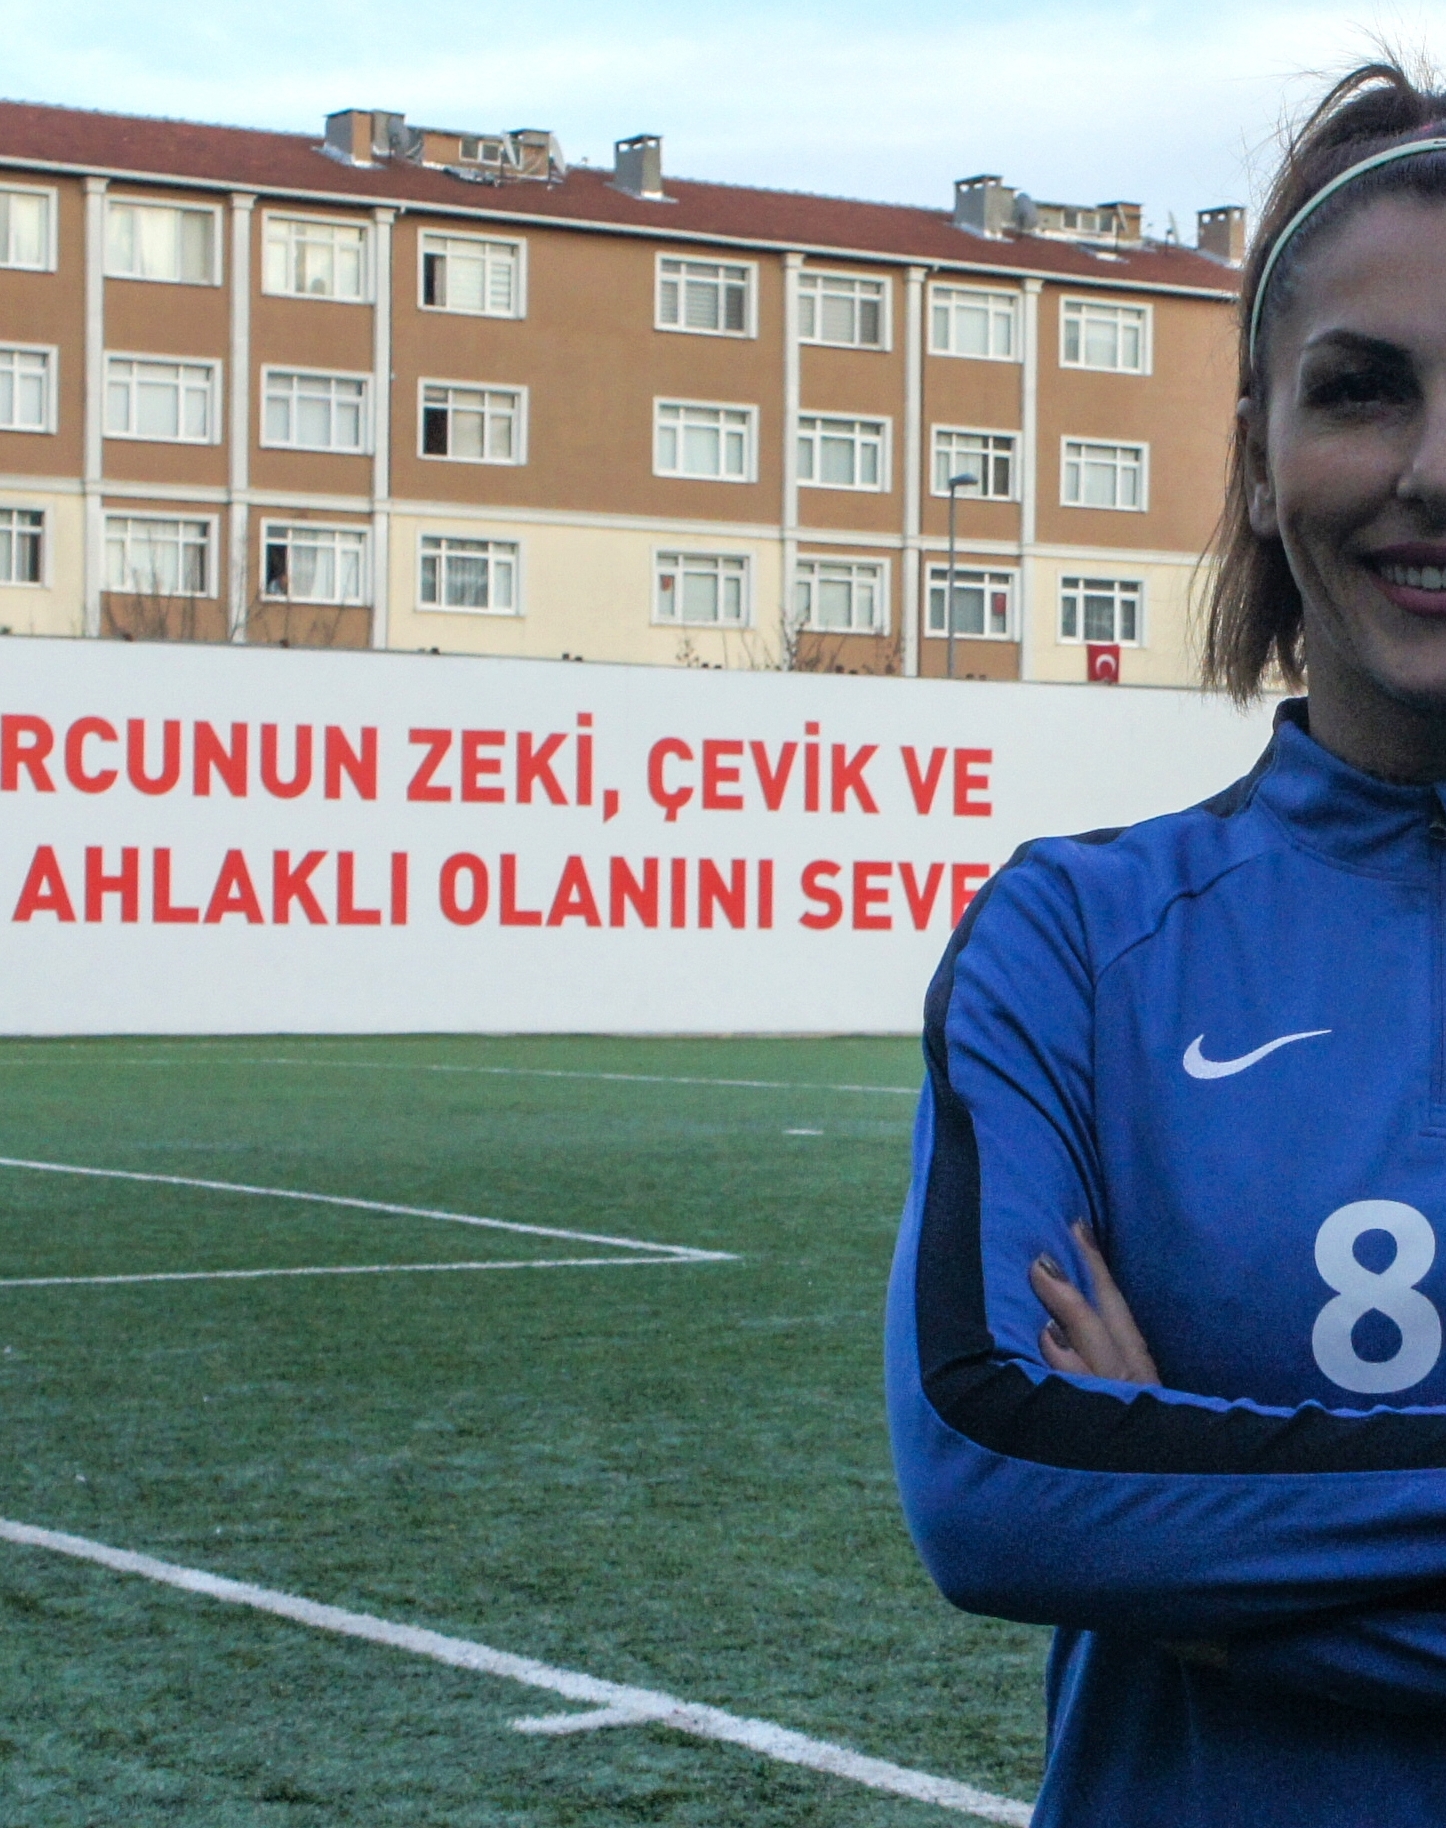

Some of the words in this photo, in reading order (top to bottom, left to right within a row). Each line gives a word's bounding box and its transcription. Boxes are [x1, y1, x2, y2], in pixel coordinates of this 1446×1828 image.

[0, 714, 379, 801] RCUNUN
[407, 712, 620, 823] ZEKİ,
[647, 721, 880, 823] ÇEVİK
[900, 746, 993, 817] VE
[13, 845, 409, 926] AHLAKLI
[439, 852, 775, 929] OLANINI
[799, 859, 1004, 931] SEVE
